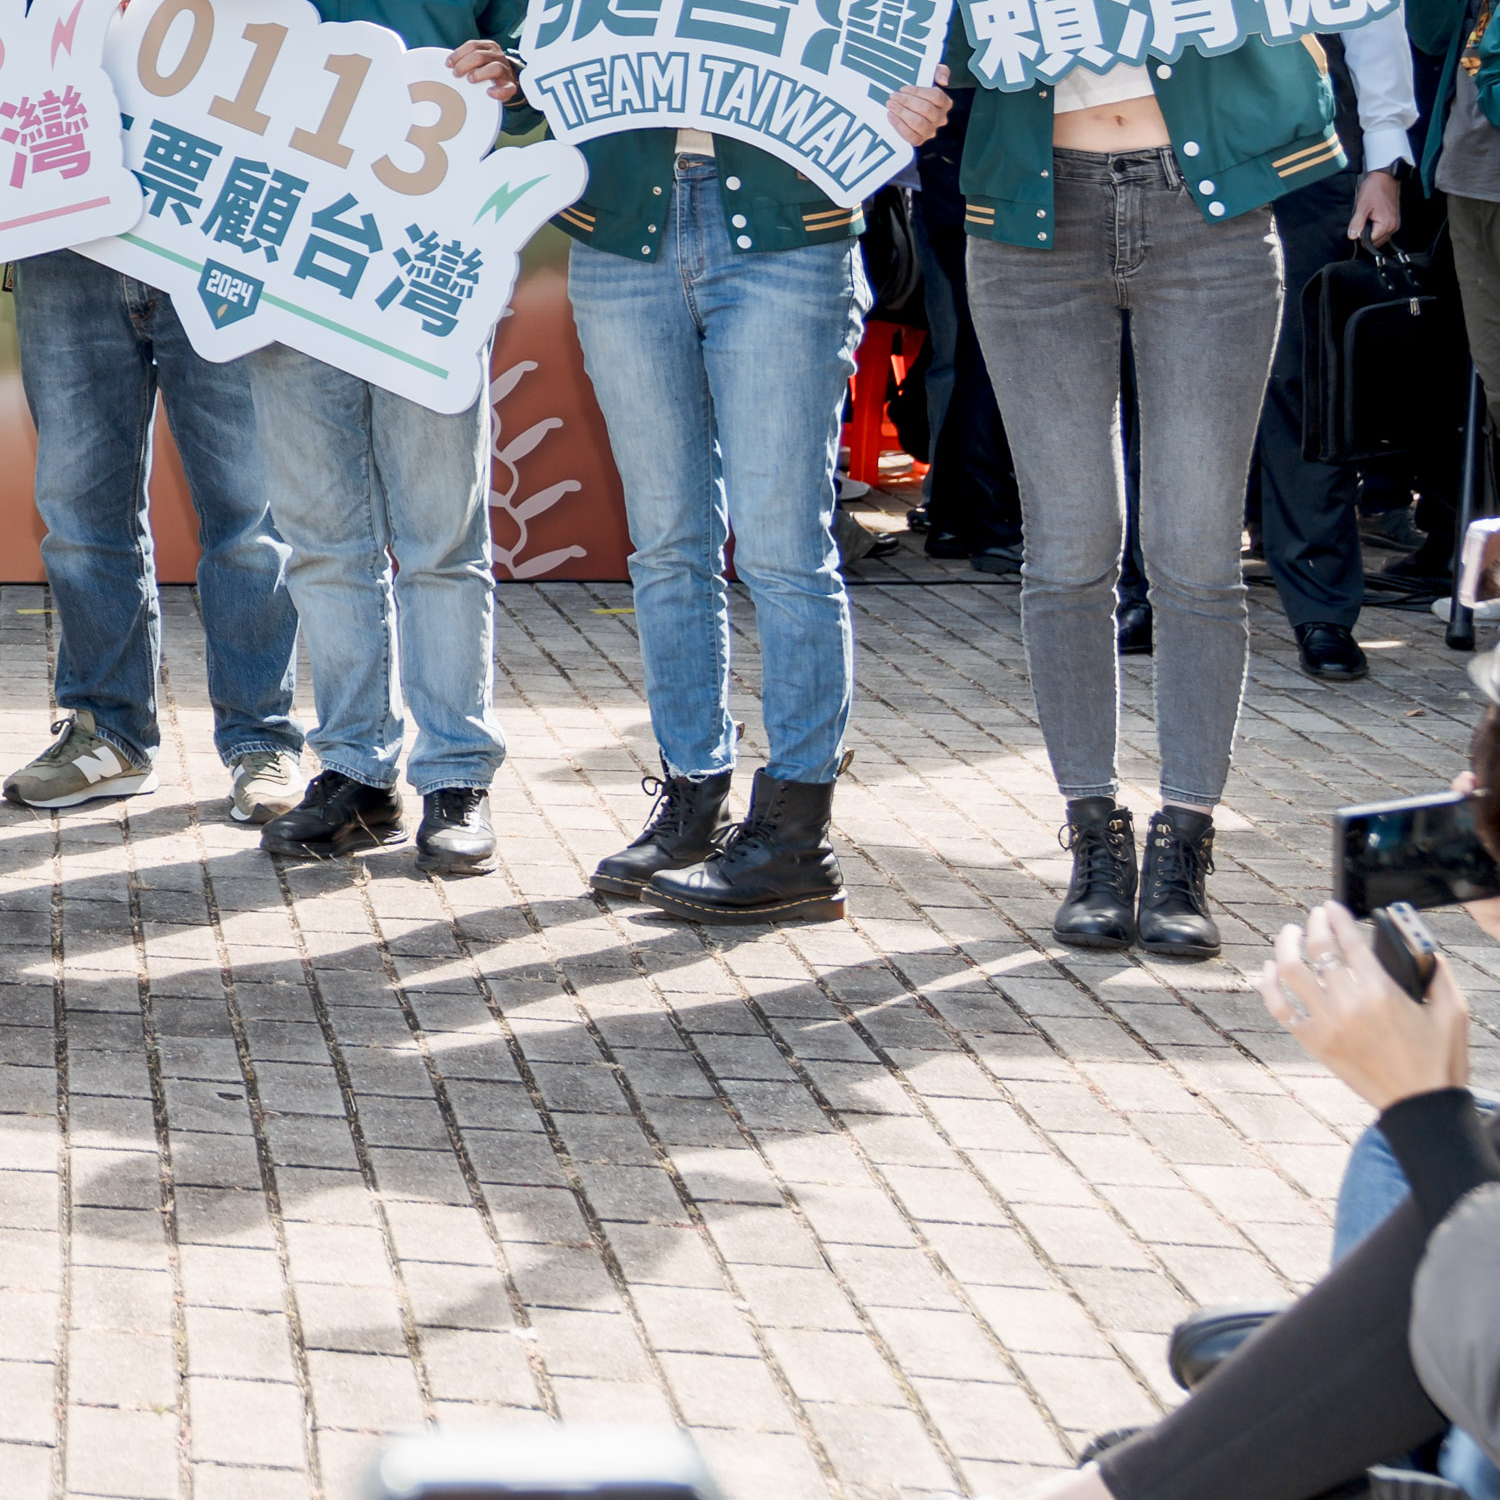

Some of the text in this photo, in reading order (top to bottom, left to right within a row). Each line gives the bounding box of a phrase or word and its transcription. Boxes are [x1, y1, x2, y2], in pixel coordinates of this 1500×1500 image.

[536, 52, 897, 194] TEAM TAIWAN
[120, 113, 485, 338] 票顧台灣
[205, 268, 254, 308] 2024
